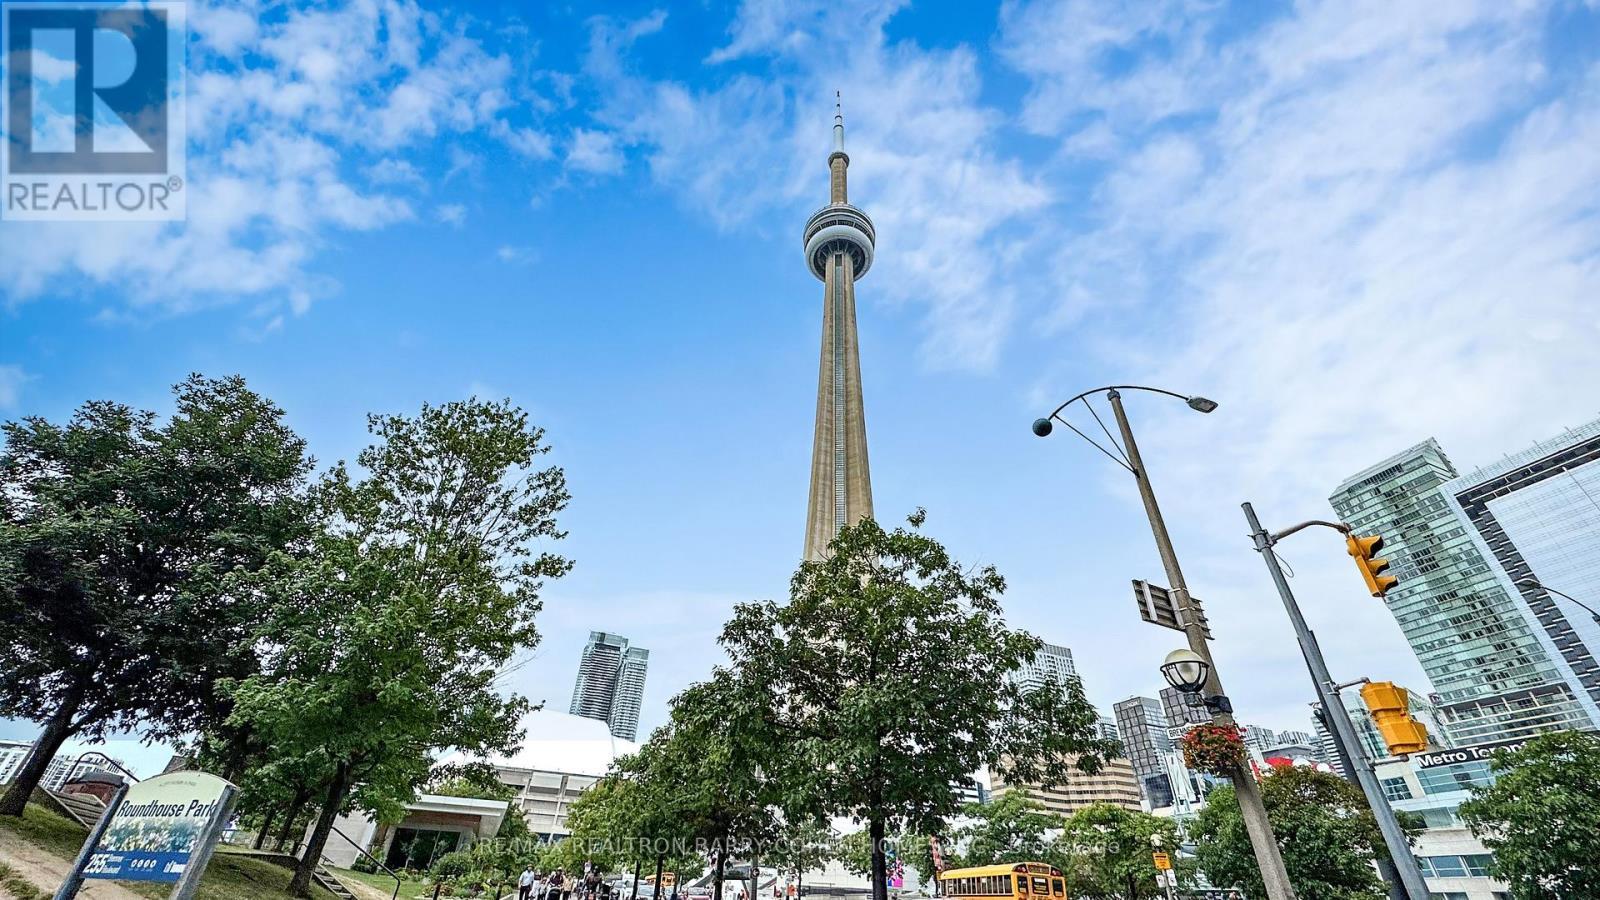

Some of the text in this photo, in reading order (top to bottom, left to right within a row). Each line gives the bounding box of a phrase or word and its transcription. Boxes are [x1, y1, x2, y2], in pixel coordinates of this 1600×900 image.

[1416, 750, 1468, 768] Metro
[117, 799, 217, 817] Roundhouse Park
[83, 854, 108, 874] 255
